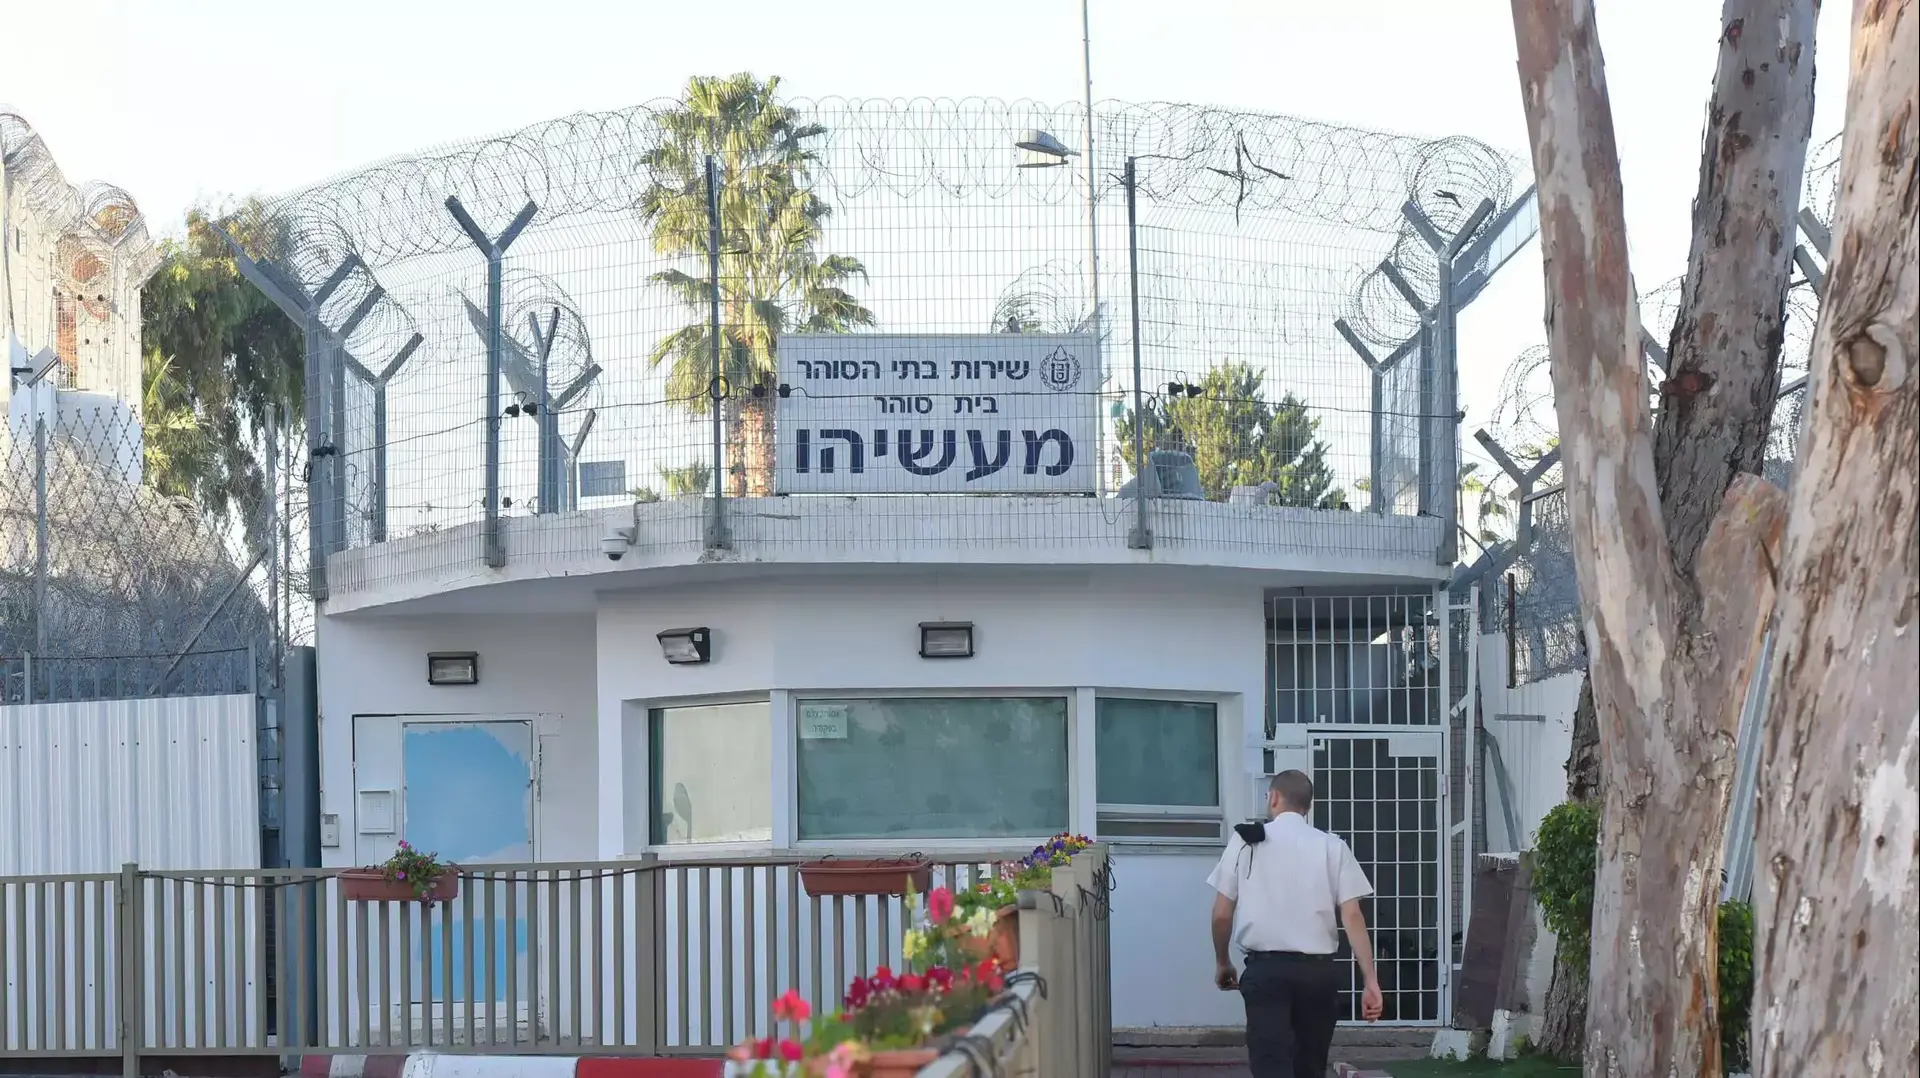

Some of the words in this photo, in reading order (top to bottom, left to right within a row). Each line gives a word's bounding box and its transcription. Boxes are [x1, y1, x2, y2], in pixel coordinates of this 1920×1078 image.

[797, 360, 880, 380] הסוהר
[892, 360, 939, 380] בתי
[951, 359, 1030, 380] שירות
[874, 397, 933, 414] סוהר
[954, 397, 999, 414] בית
[796, 428, 1074, 482] מעשיהו
